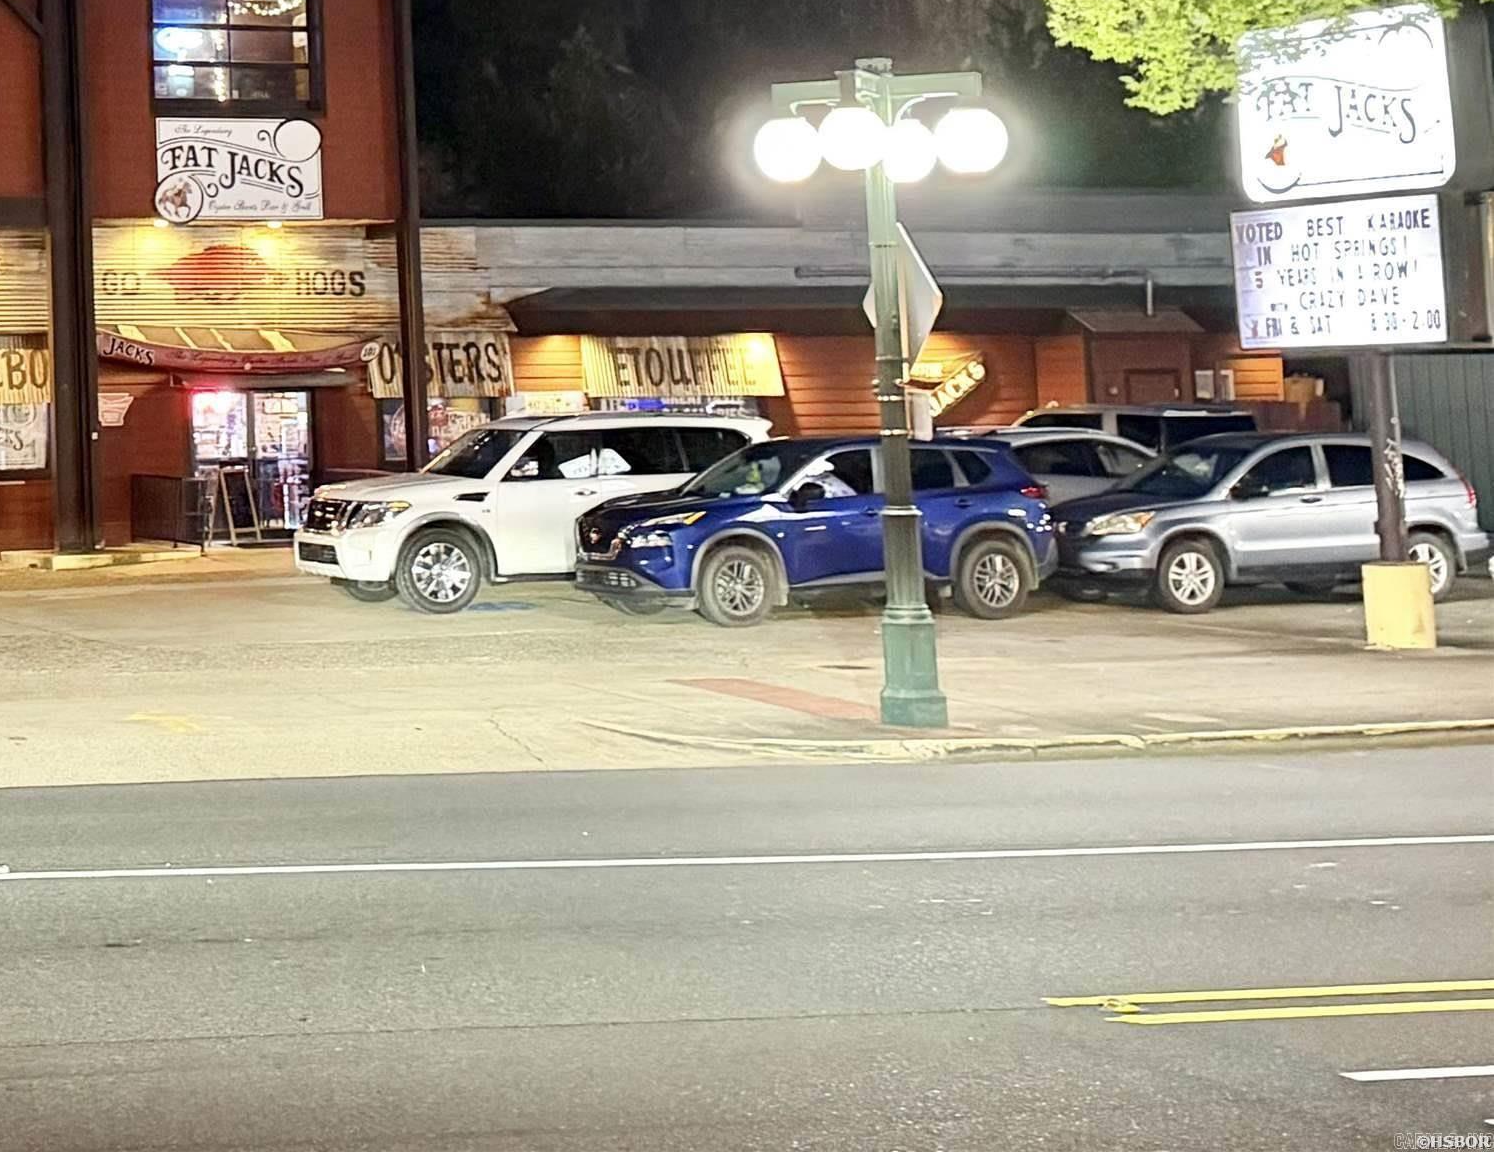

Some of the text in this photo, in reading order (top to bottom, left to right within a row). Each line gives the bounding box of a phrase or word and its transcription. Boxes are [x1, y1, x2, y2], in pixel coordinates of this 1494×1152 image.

[1328, 85, 1416, 144] JACKS
[161, 145, 304, 198] FAT JACKS
[1236, 208, 1431, 244] VOTED BEST KARAOKE
[1257, 246, 1272, 266] IN
[1291, 243, 1319, 262] HOT
[102, 269, 366, 297] GO HOGS
[1300, 290, 1344, 310] CRAZY
[1358, 286, 1400, 307] DAVE
[1310, 315, 1331, 334] SAT
[103, 338, 155, 366] JACKS
[379, 342, 501, 384] OTERS
[929, 361, 985, 417] JACKS
